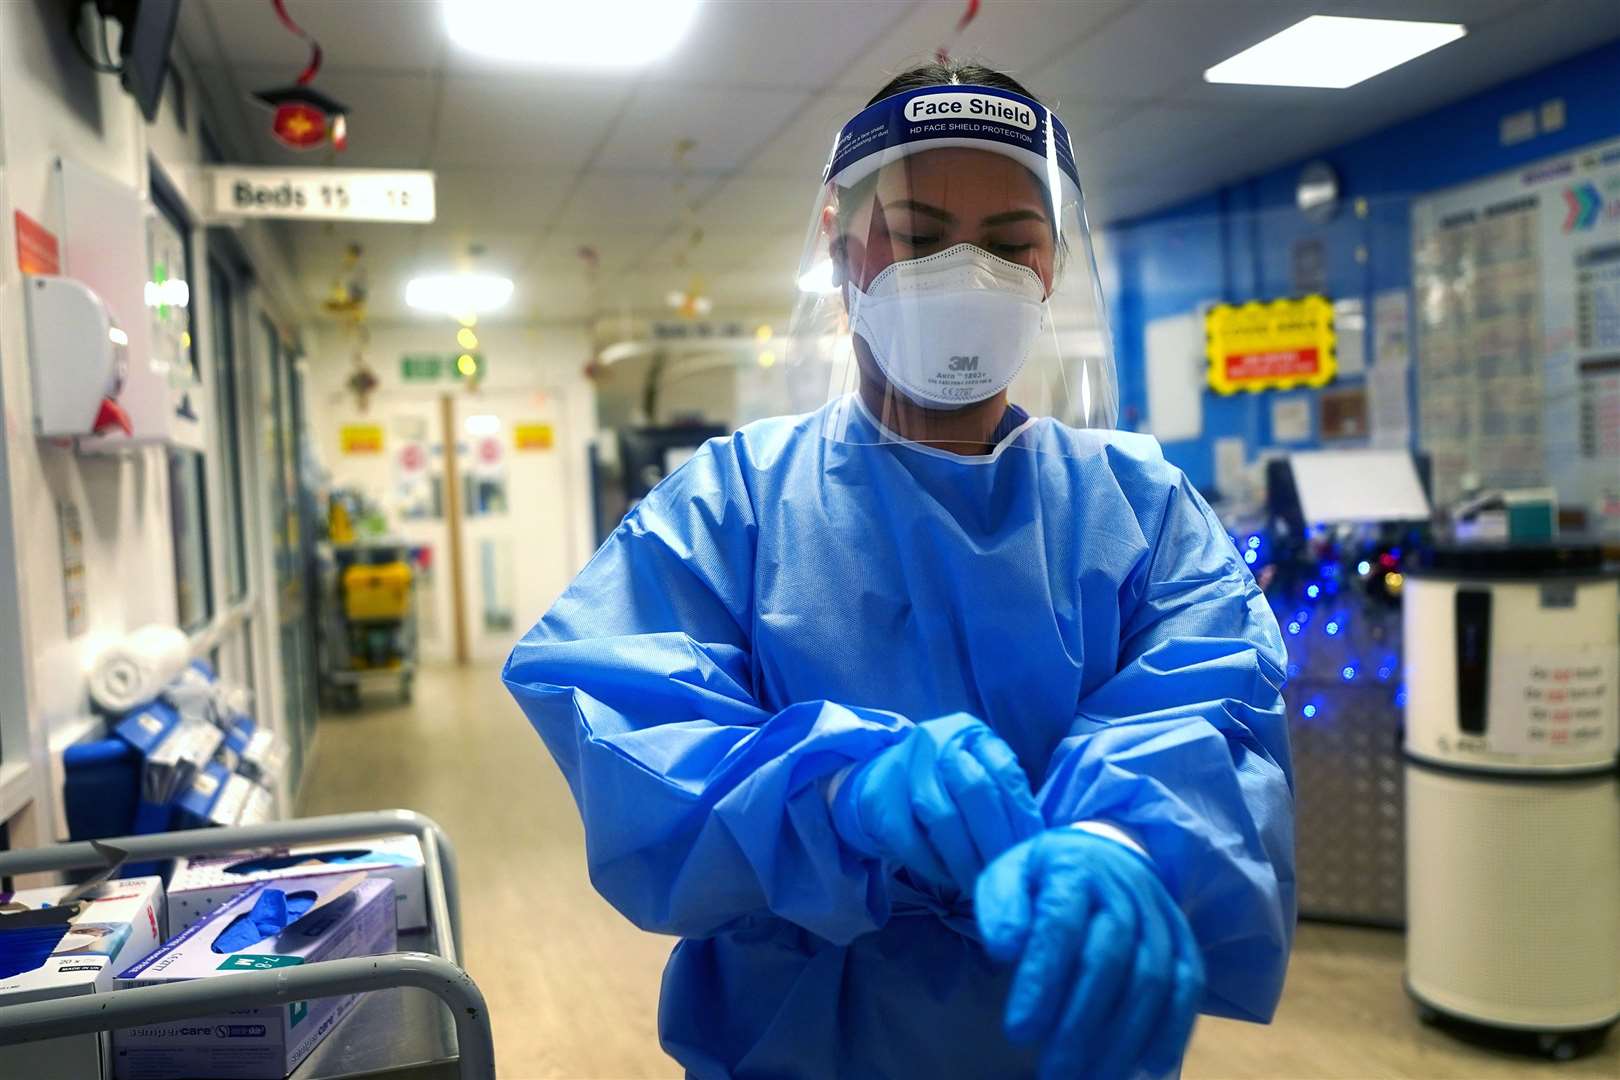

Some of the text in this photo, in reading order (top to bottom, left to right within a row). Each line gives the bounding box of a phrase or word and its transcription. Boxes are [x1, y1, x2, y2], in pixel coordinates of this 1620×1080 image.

[913, 99, 1030, 126] Face Shield
[910, 123, 1033, 143] HD FACE SHIELD PROTECTION
[233, 179, 307, 208] Beds
[949, 356, 979, 371] 3M
